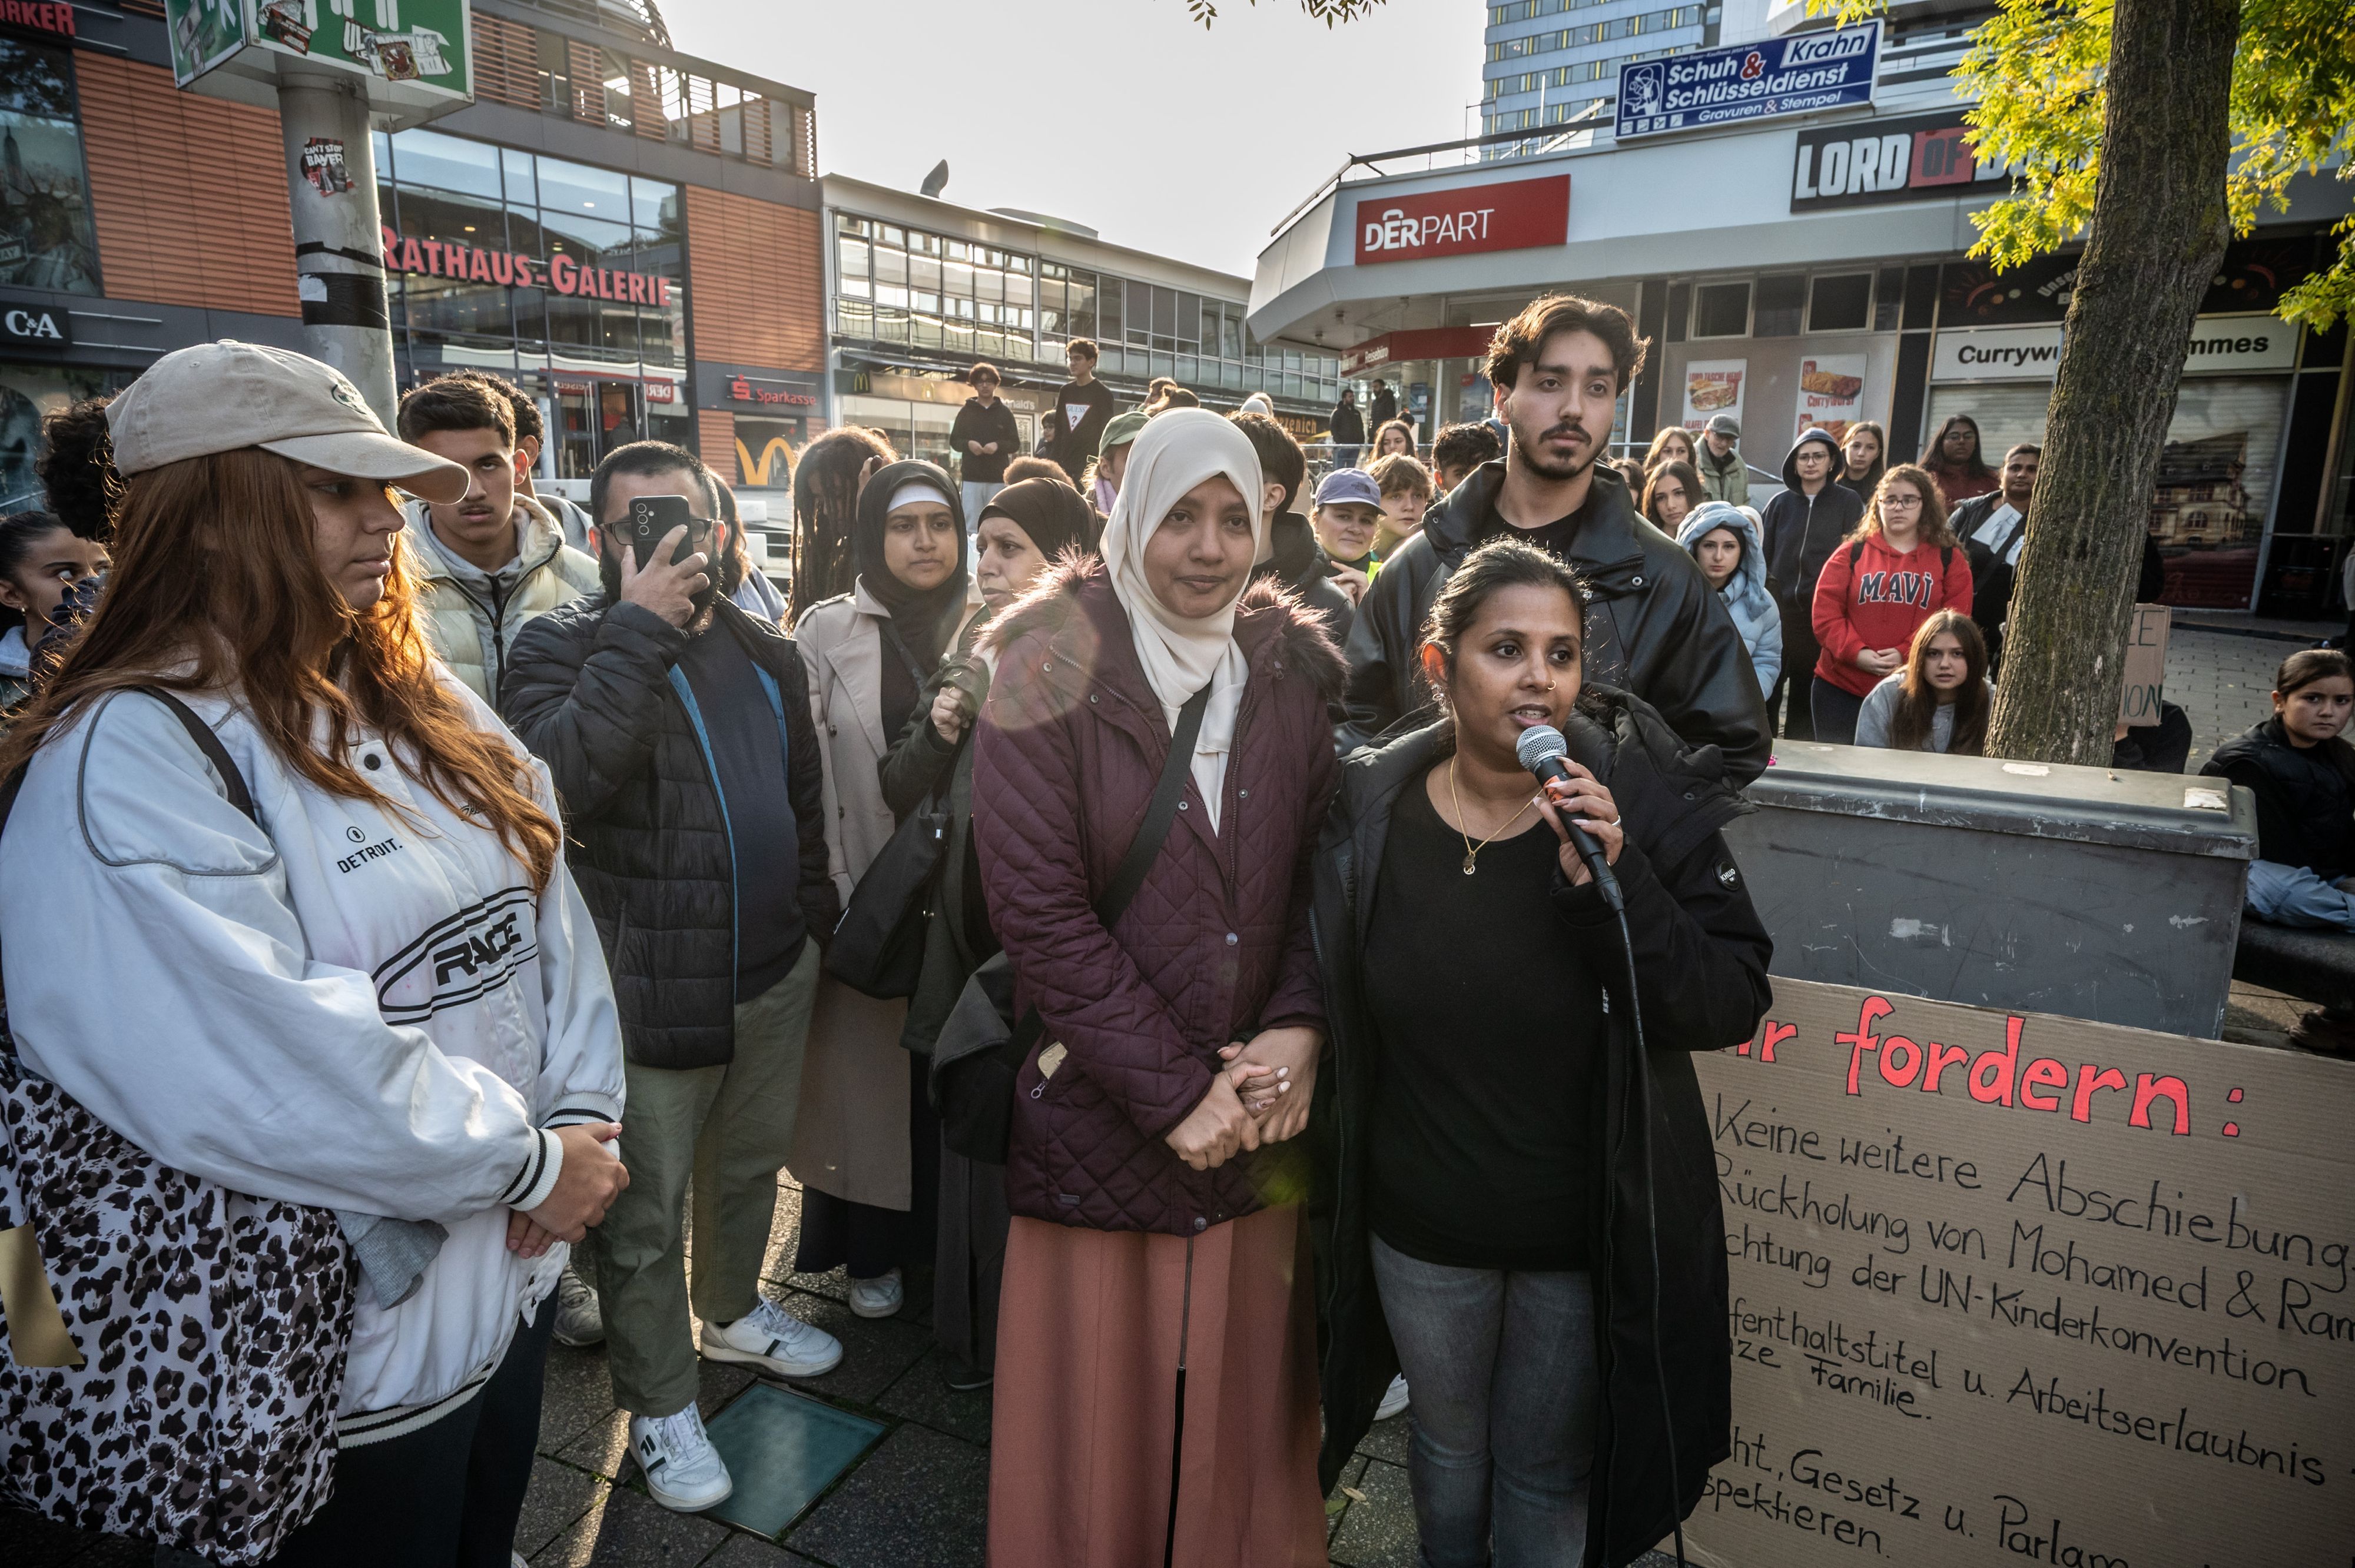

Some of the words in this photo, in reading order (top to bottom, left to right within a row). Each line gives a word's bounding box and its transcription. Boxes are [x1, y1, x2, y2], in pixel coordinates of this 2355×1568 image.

[1667, 57, 1738, 85] Schuh
[1740, 51, 1766, 81] &
[1789, 34, 1866, 63] Krahn
[1666, 61, 1849, 109] Schlüsseldienst
[1698, 104, 1763, 122] Gravuren
[1763, 99, 1778, 115] &
[1780, 90, 1842, 110] Stempel
[306, 152, 344, 167] BAYER
[324, 144, 343, 153] STOP
[1794, 133, 1912, 200] LORD
[1921, 132, 1968, 179] OF
[1365, 208, 1495, 252] DERPART
[383, 224, 671, 308] RATHAUS-GALERIE
[5, 310, 63, 339] C&A
[2188, 336, 2269, 356] mmes
[756, 388, 817, 405] Sparkasse
[337, 838, 403, 874] DETROIT.
[433, 912, 522, 986] RACE
[1716, 1093, 1826, 1161] Keine
[1840, 1128, 1982, 1189] weitere
[2006, 1152, 2355, 1293] Abschiebung
[1927, 1221, 1986, 1260] von
[2008, 1219, 2206, 1312] Mohamed
[2225, 1270, 2266, 1323] &
[1725, 1223, 1832, 1289] chtung
[1852, 1254, 1907, 1294] der
[1920, 1265, 2317, 1397] UN-Kinderkonvention
[1729, 1297, 1943, 1389] fenthaltstitel
[1964, 1369, 1995, 1398] u.
[2006, 1367, 2326, 1486] Arbeitserlaubnis
[1804, 1353, 1932, 1420] Familie.
[1701, 1475, 1891, 1559] spektieren.
[1790, 1449, 1920, 1520] Gesetz
[1945, 1505, 1973, 1538] u.
[1993, 1495, 2129, 1568] Parlam
